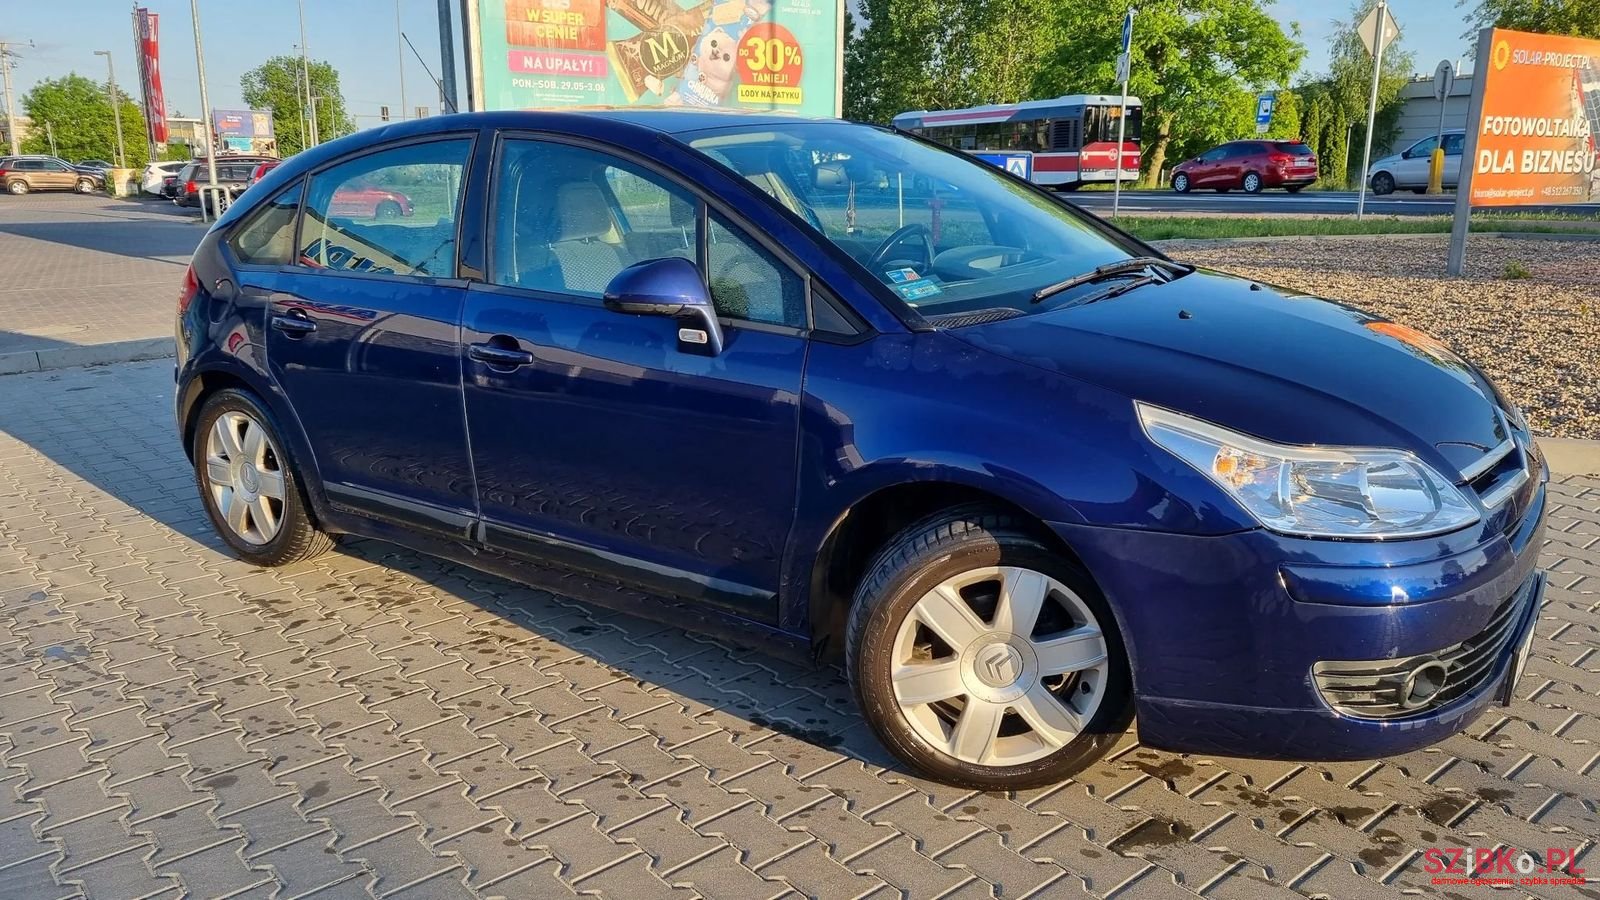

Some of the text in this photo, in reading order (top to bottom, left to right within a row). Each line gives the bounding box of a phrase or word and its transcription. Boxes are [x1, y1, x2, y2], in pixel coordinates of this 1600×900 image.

[526, 8, 584, 26] W SUPER
[536, 25, 578, 40] CENIE
[653, 52, 686, 73] MAGNUM
[746, 36, 801, 72] 30%
[1513, 50, 1591, 69] SOLAR-PROJECT.PL
[523, 56, 593, 72] NA UPAŁY!
[561, 81, 606, 92] 29.05-3.06
[752, 72, 789, 84] TANIEJ!
[740, 89, 800, 99] LODY NA PATYKU
[1483, 116, 1591, 137] FOTOWOLTAIKA
[1478, 149, 1595, 174] DLA BIZNESU
